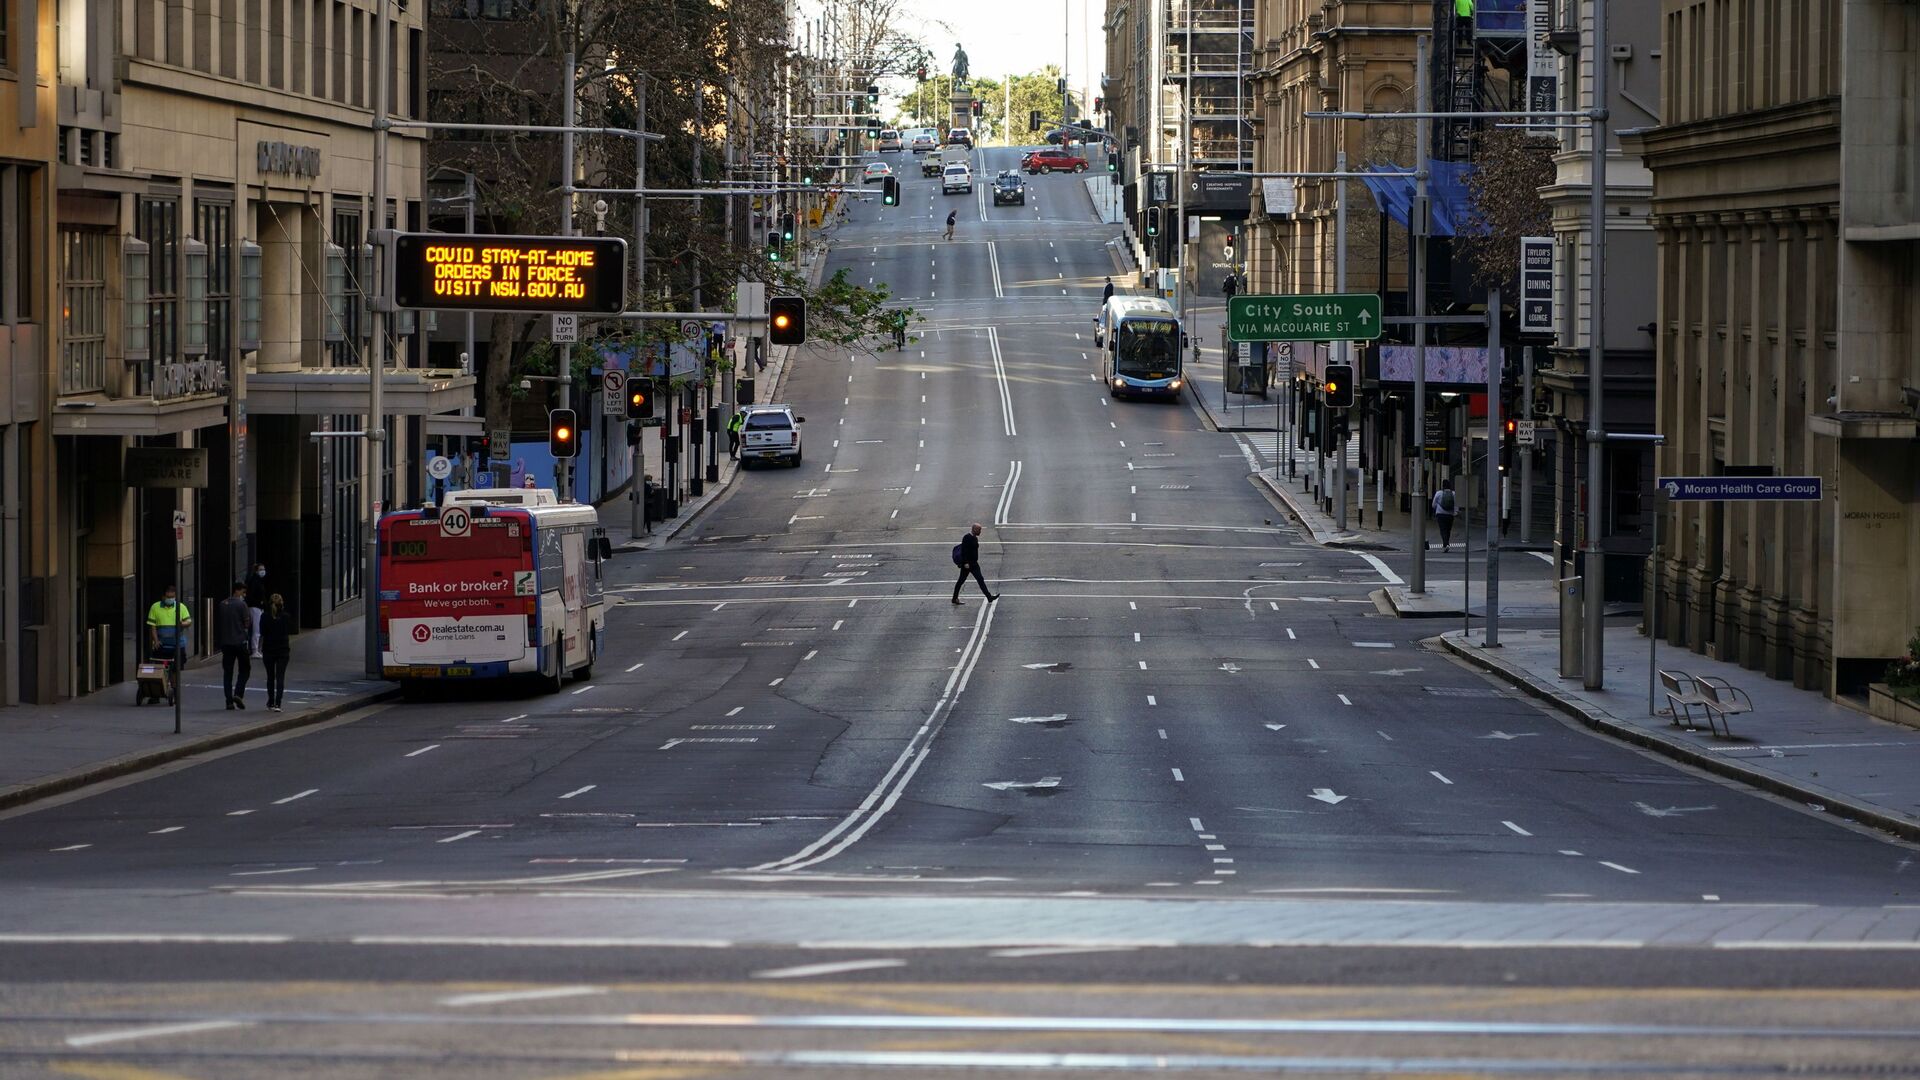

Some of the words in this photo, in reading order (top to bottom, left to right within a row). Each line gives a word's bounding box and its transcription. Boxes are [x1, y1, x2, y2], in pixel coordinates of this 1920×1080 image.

[426, 246, 474, 263] COVID
[481, 248, 595, 267] STAY-AT-HOME
[1527, 248, 1551, 256] TAYLOR'S
[1527, 257, 1551, 265] ROOFTOP
[435, 264, 492, 280] ORDERS
[502, 265, 520, 281] IN
[527, 266, 582, 282] FORCE.
[434, 280, 482, 296] VISIT
[490, 281, 585, 299] NSW.GOV.AU
[1527, 279, 1551, 290] DINING
[1245, 304, 1282, 319] City
[1293, 303, 1342, 316] South
[1533, 305, 1543, 313] VIP
[558, 317, 572, 325] NO
[1528, 314, 1548, 322] LOUNGE
[685, 326, 697, 335] 40
[1238, 323, 1258, 333] VIA
[1263, 322, 1331, 333] MACQUARIE
[1336, 321, 1351, 332] ST
[493, 431, 507, 439] ONE
[493, 440, 508, 448] WAY
[132, 457, 201, 468] CHANGE
[1684, 484, 1717, 494] Moran
[1720, 483, 1754, 493] Health
[1756, 483, 1781, 493] Care
[1784, 484, 1817, 495] Group
[444, 514, 466, 529] 40
[409, 582, 440, 594] Bank
[443, 583, 456, 593] or
[460, 579, 509, 591] broker?
[424, 599, 450, 608] We've
[452, 599, 467, 609] got
[469, 598, 492, 606] both.
[432, 624, 505, 634] realestate.com.au
